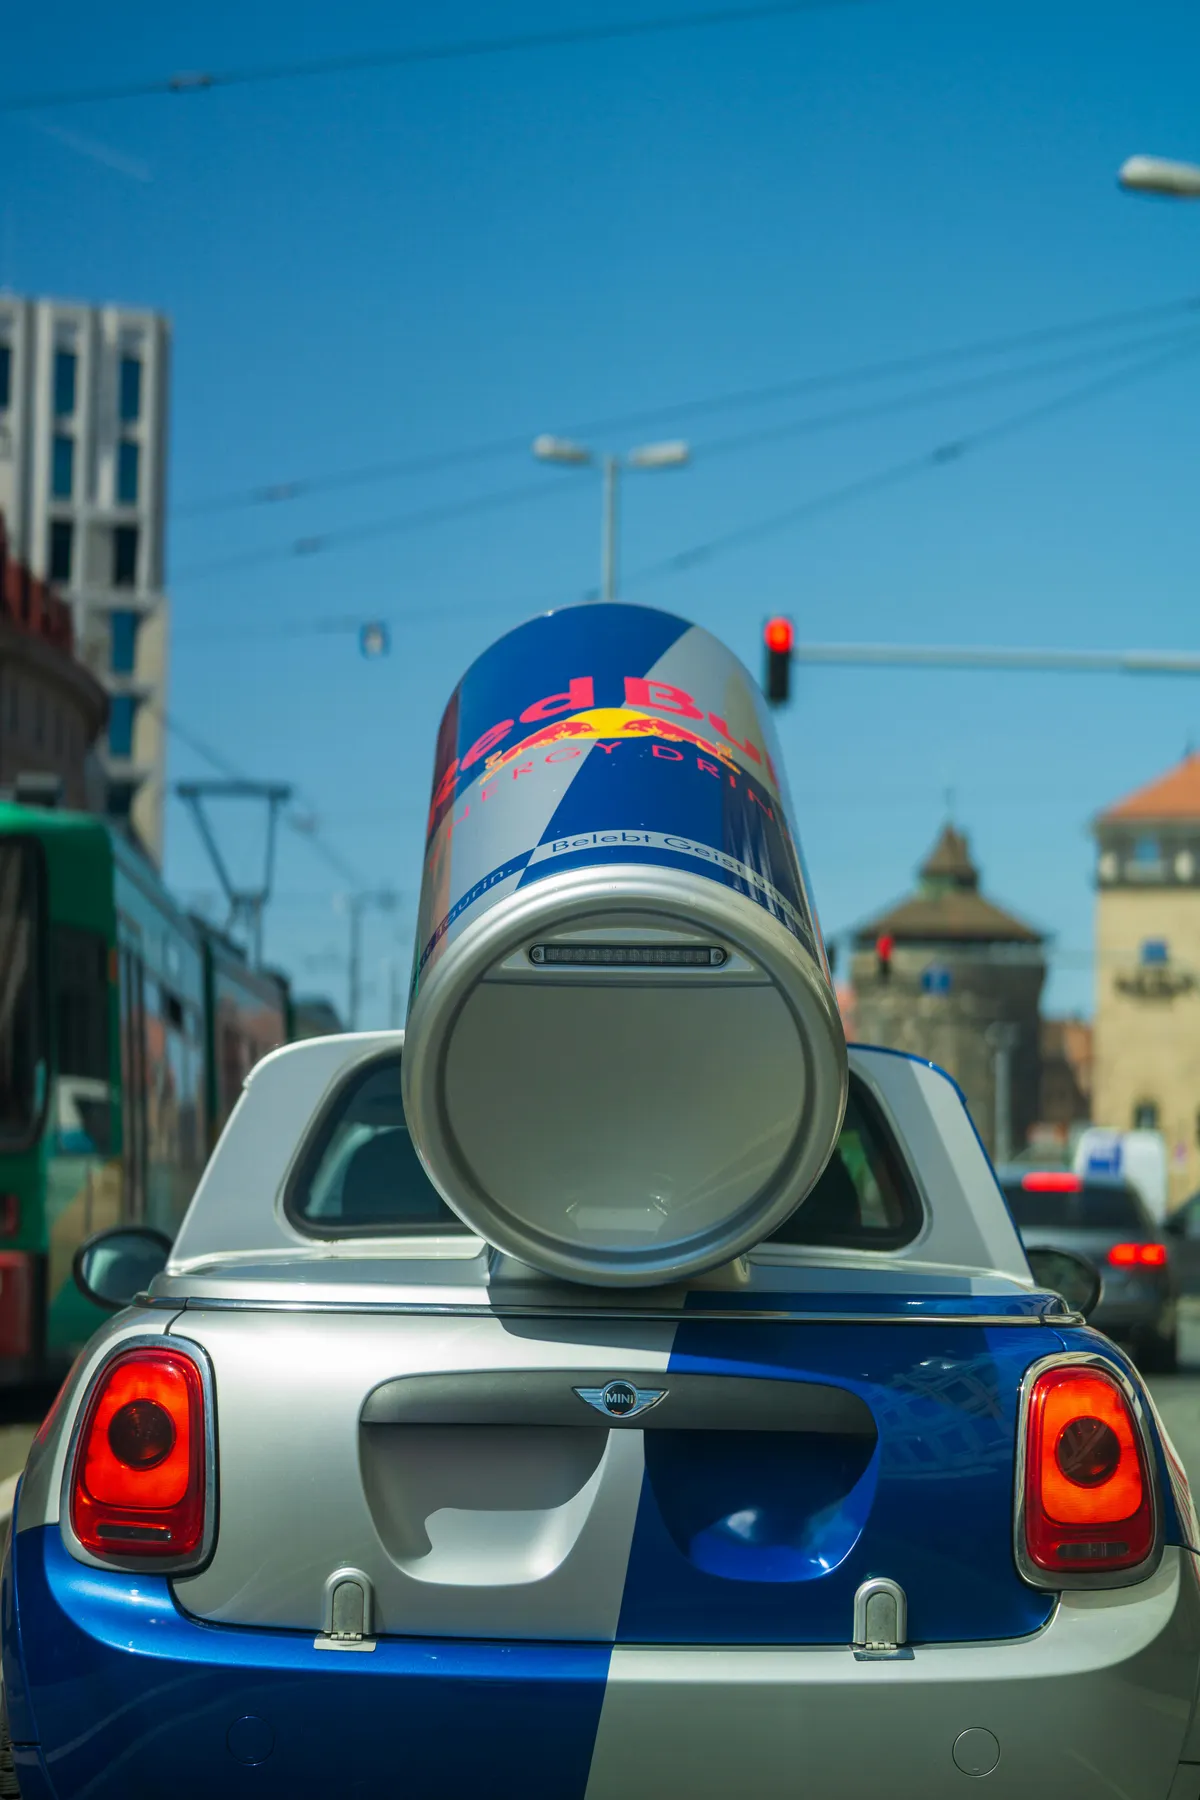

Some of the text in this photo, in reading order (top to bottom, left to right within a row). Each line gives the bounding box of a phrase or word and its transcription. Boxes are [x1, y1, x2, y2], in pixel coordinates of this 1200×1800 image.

[552, 831, 652, 853] Belebt
[663, 837, 742, 873] Geist
[606, 1393, 634, 1404] MINI
